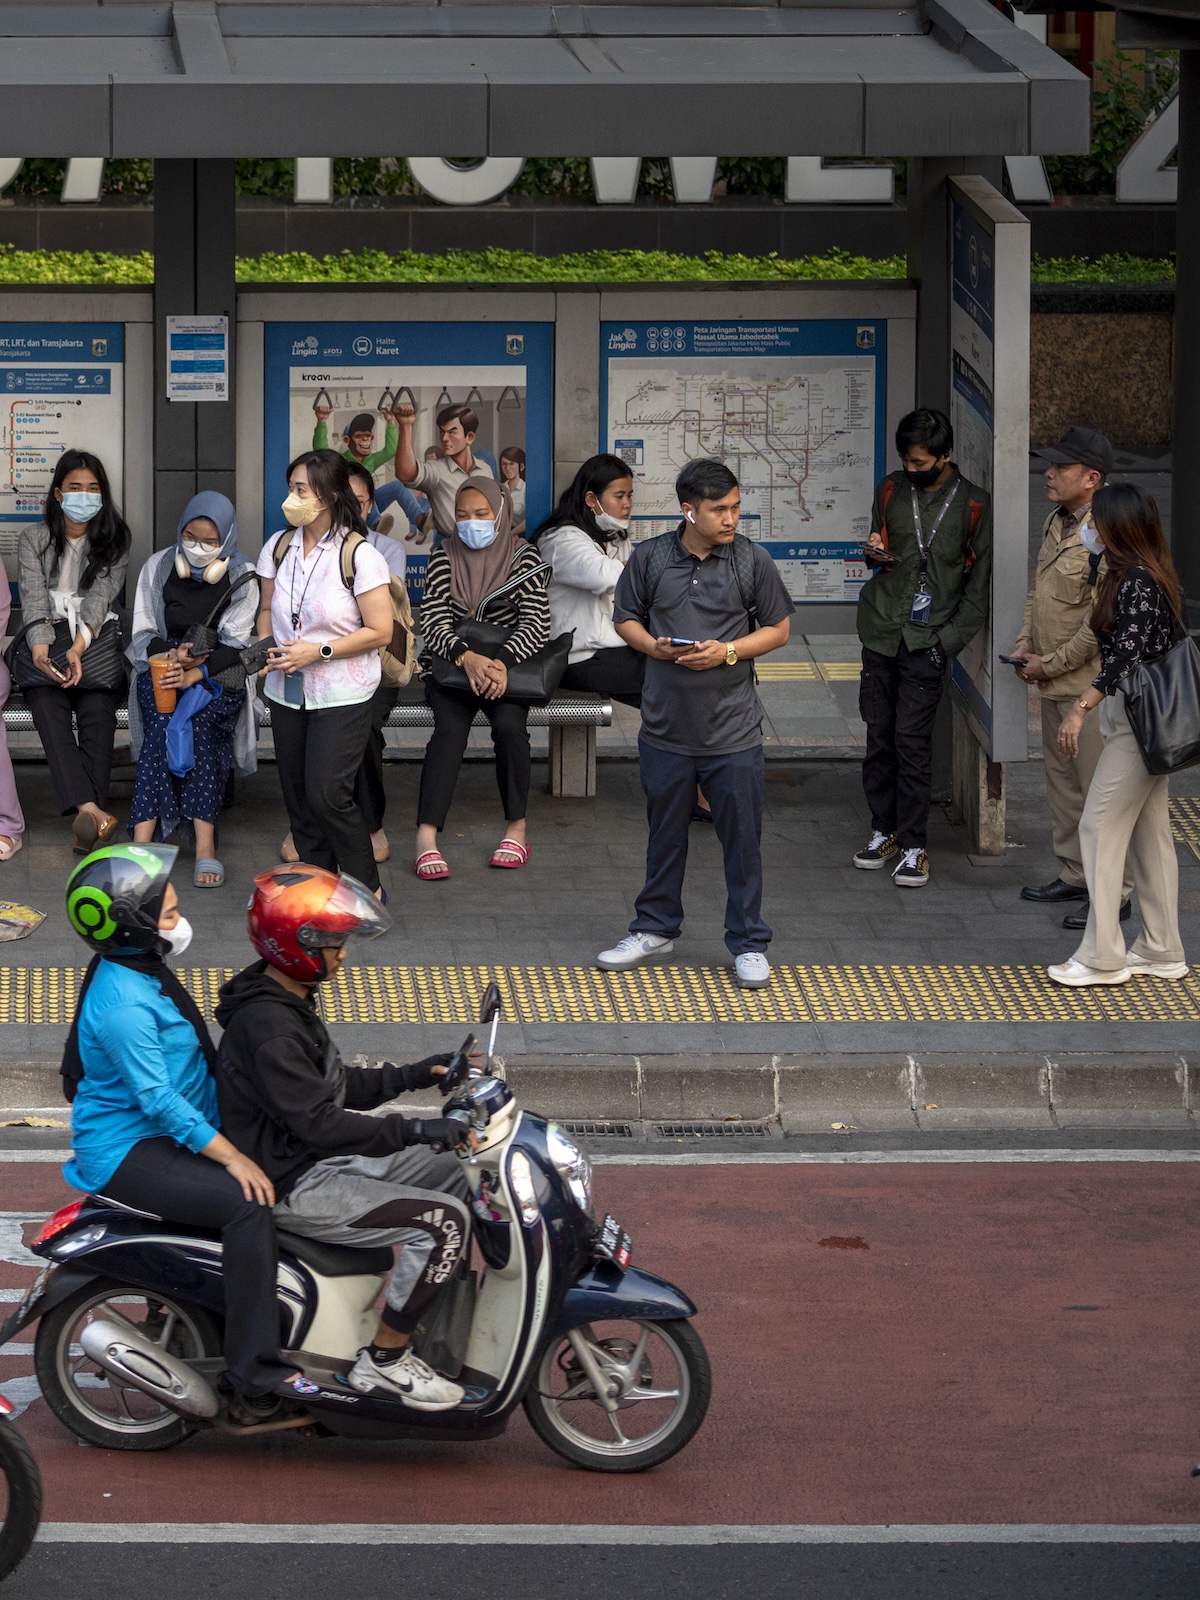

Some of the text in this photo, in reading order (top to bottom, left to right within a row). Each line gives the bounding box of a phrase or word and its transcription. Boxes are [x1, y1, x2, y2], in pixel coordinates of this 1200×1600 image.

[709, 326, 737, 334] Jaringan
[738, 326, 777, 334] Transportasi
[609, 333, 623, 341] Jak
[11, 339, 26, 348] LRT,
[27, 339, 39, 347] dan
[41, 339, 83, 349] Transjakarta
[608, 341, 636, 351] Lingko
[291, 347, 318, 357] Lingko
[376, 347, 400, 355] Karet
[302, 373, 330, 381] kreavi
[845, 569, 863, 578] 112
